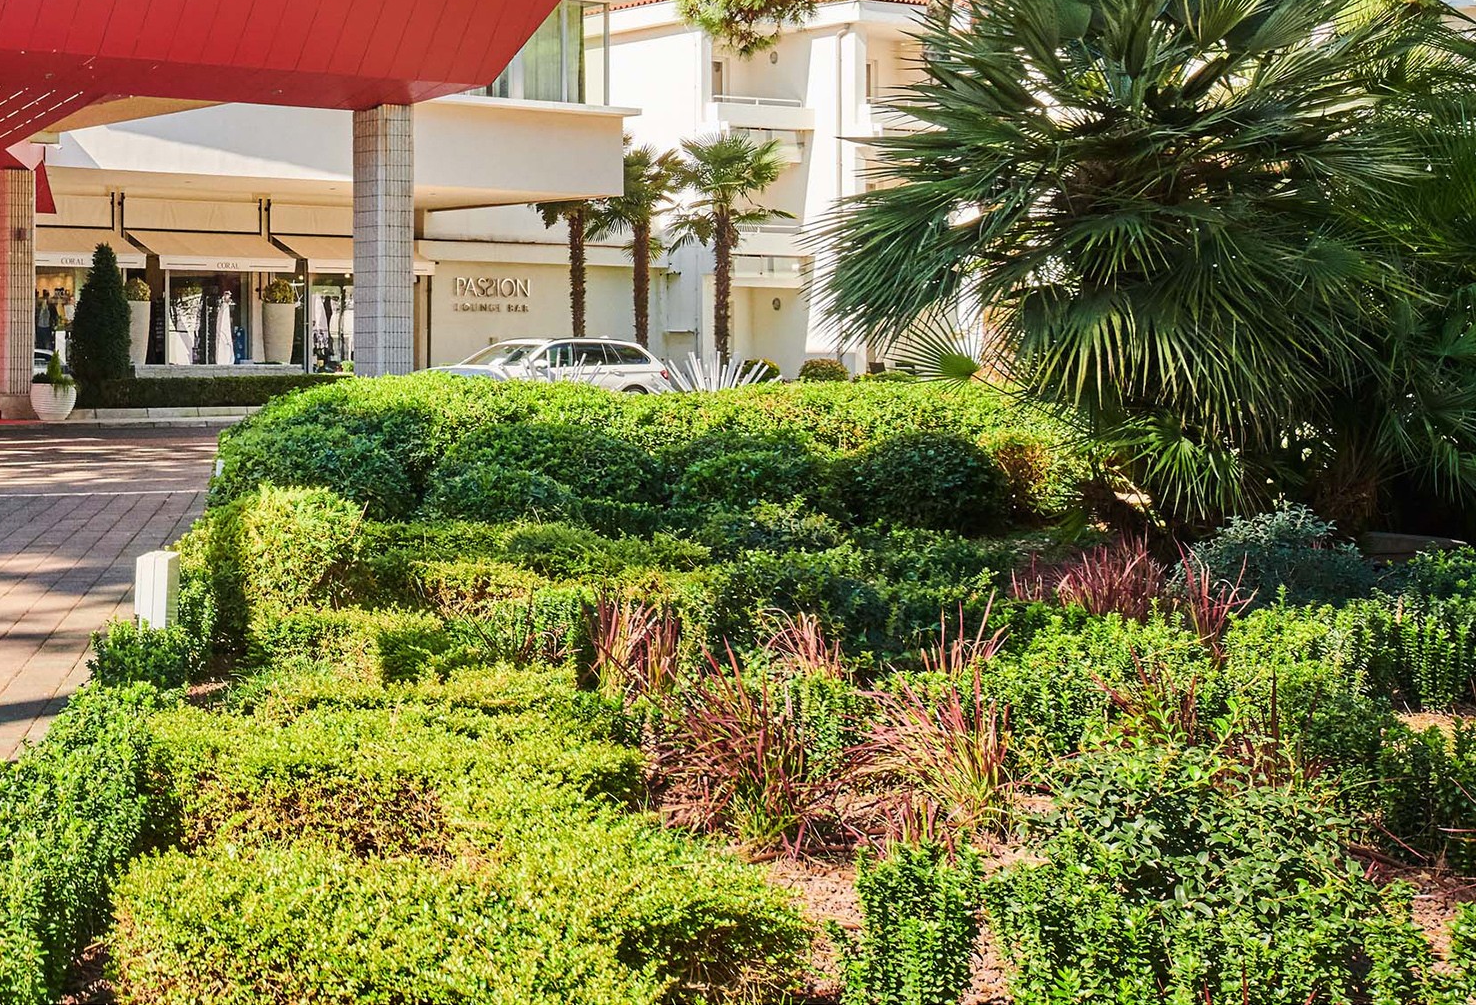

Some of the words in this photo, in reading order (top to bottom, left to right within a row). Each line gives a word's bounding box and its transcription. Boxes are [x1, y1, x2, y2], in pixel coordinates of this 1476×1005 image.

[60, 257, 85, 265] CORAL
[454, 276, 531, 297] PASSION
[454, 302, 501, 312] LOUNGE
[507, 303, 529, 313] BAR
